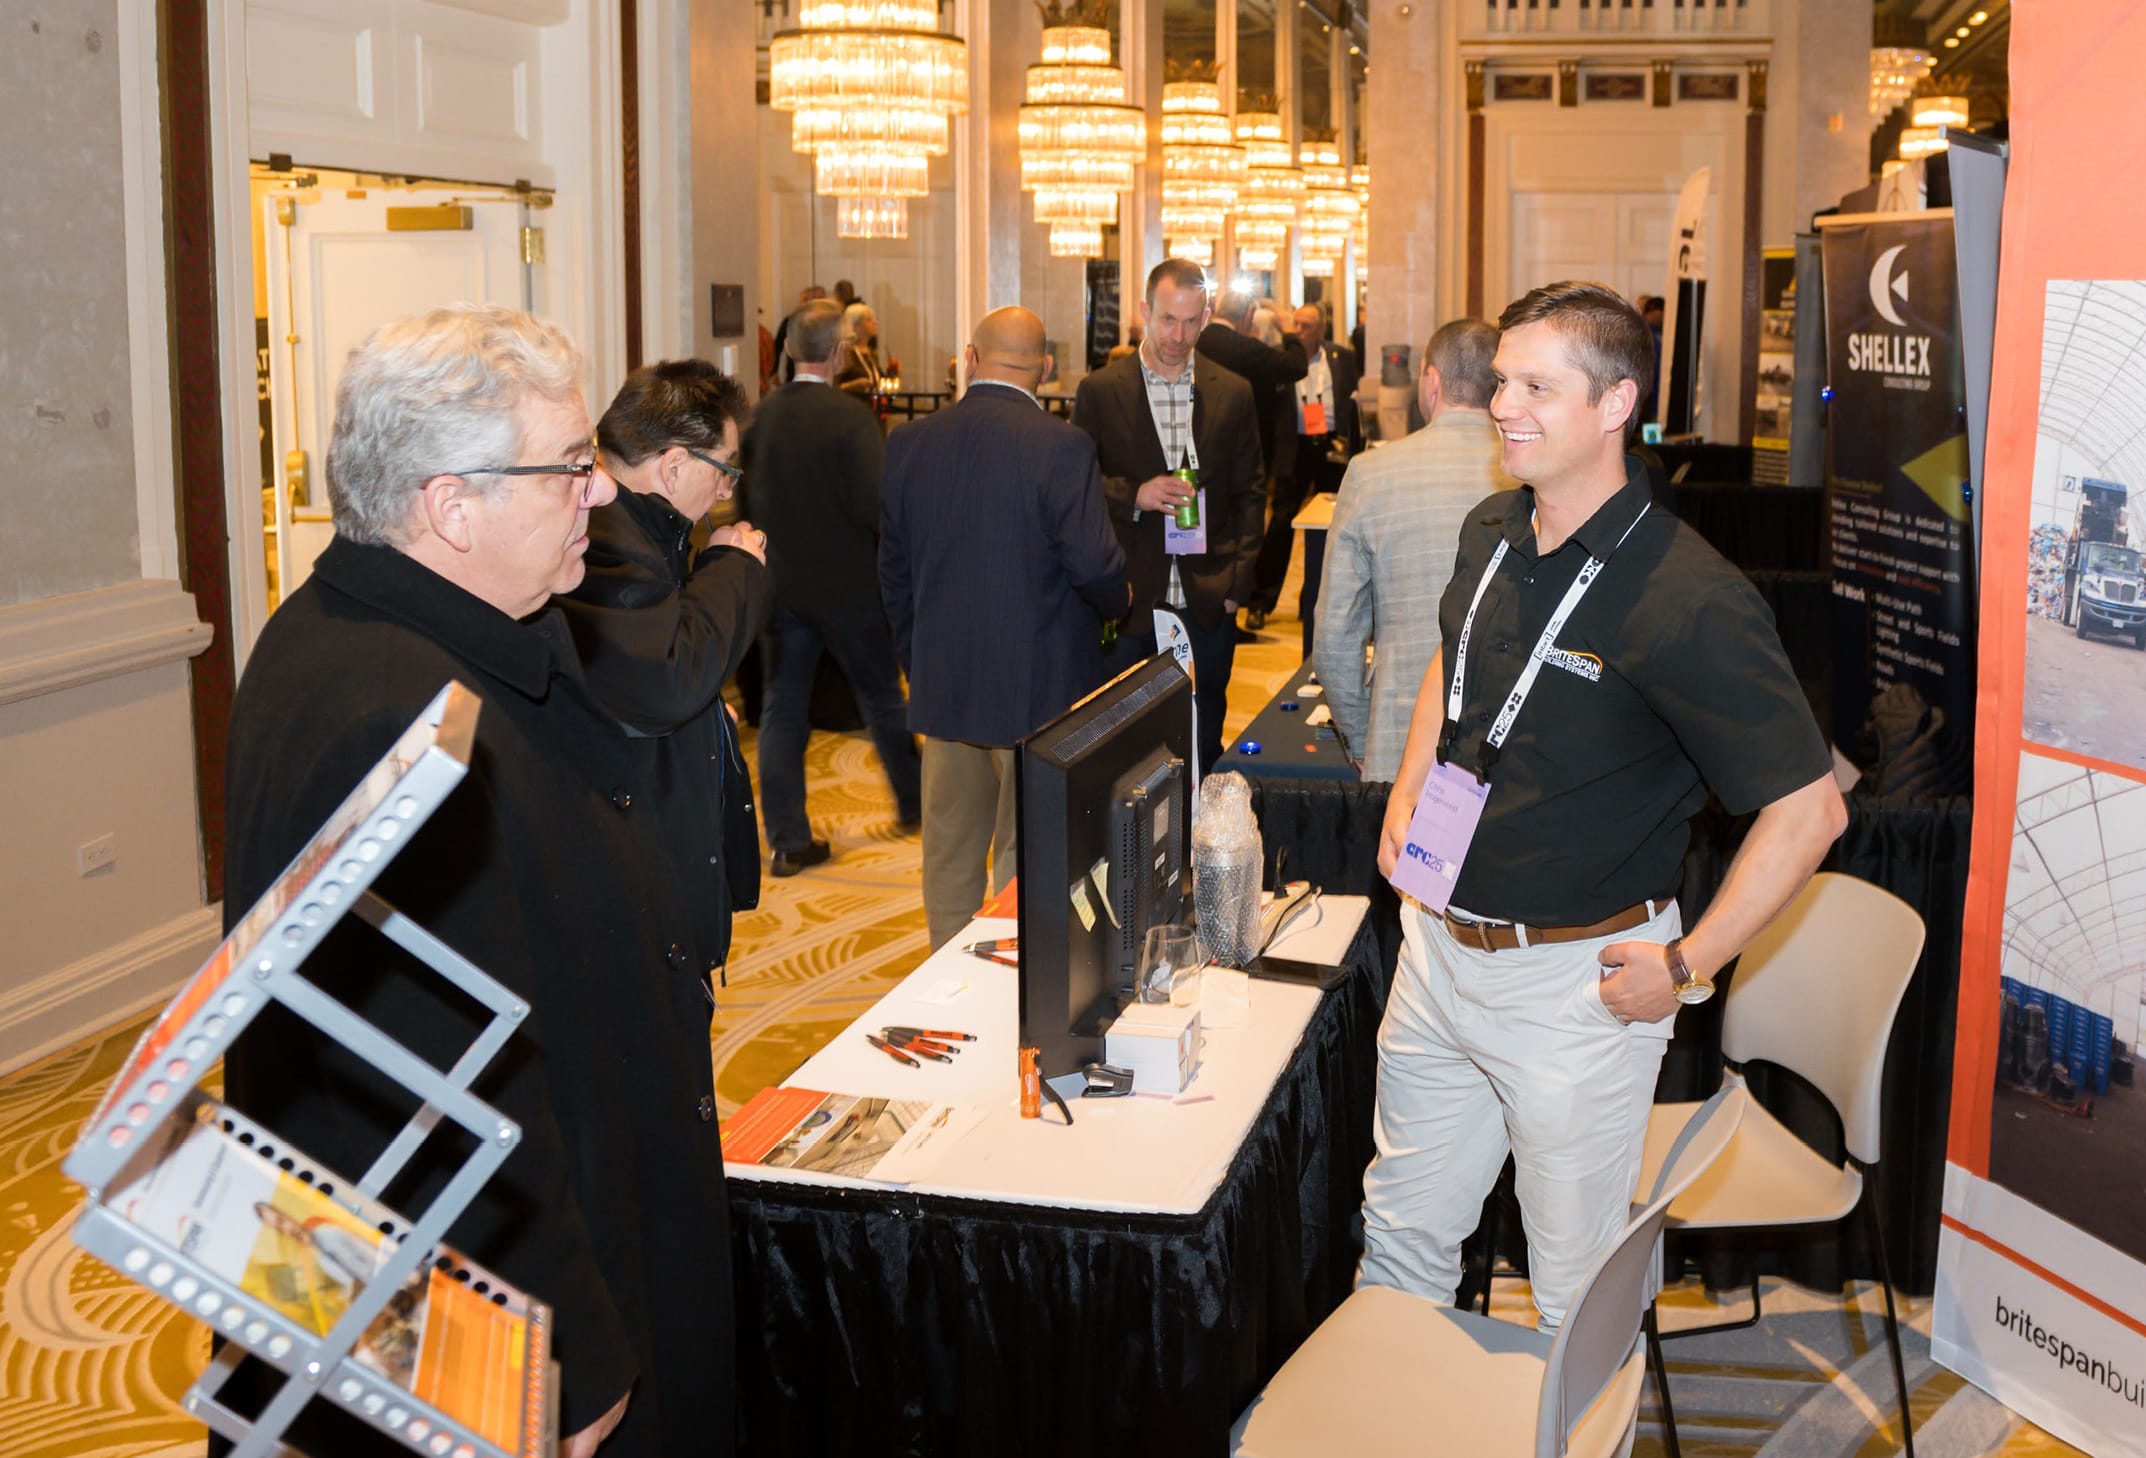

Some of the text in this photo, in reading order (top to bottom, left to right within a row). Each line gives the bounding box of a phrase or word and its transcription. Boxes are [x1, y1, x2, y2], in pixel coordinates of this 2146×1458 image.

[1848, 333, 1931, 376] SHELLEX
[1546, 645, 1600, 675] BRITESPAN
[1405, 841, 1445, 873] crc25
[1995, 1296, 2145, 1408] britespanbui
